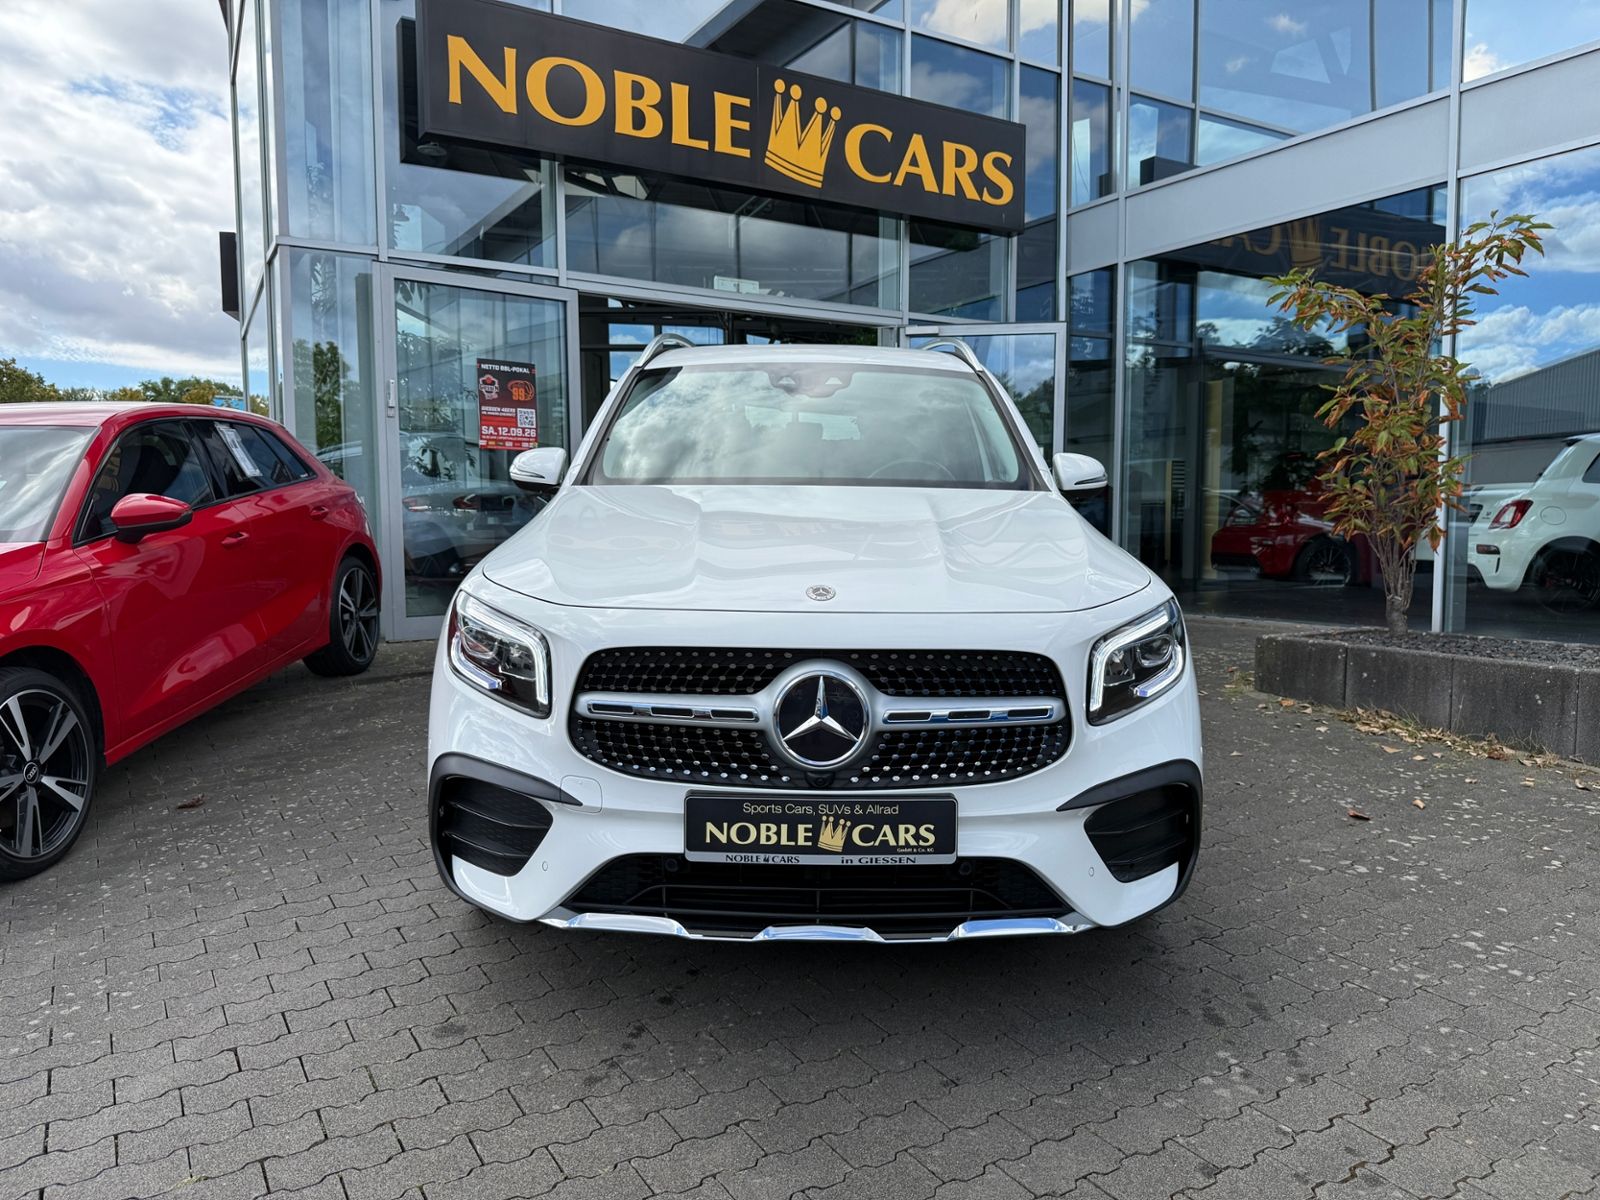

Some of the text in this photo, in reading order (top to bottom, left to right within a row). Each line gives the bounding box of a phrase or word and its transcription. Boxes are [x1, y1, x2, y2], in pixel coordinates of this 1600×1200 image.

[447, 35, 1015, 206] NOBLE CARS
[481, 363, 530, 374] NETTO BBL-POKAL
[743, 802, 899, 815] Sports Cars, SUVs & Allrad
[705, 821, 936, 847] NOBLE CARS
[725, 854, 800, 864] NOBLE CARS
[841, 856, 917, 864] in GIESSEN
